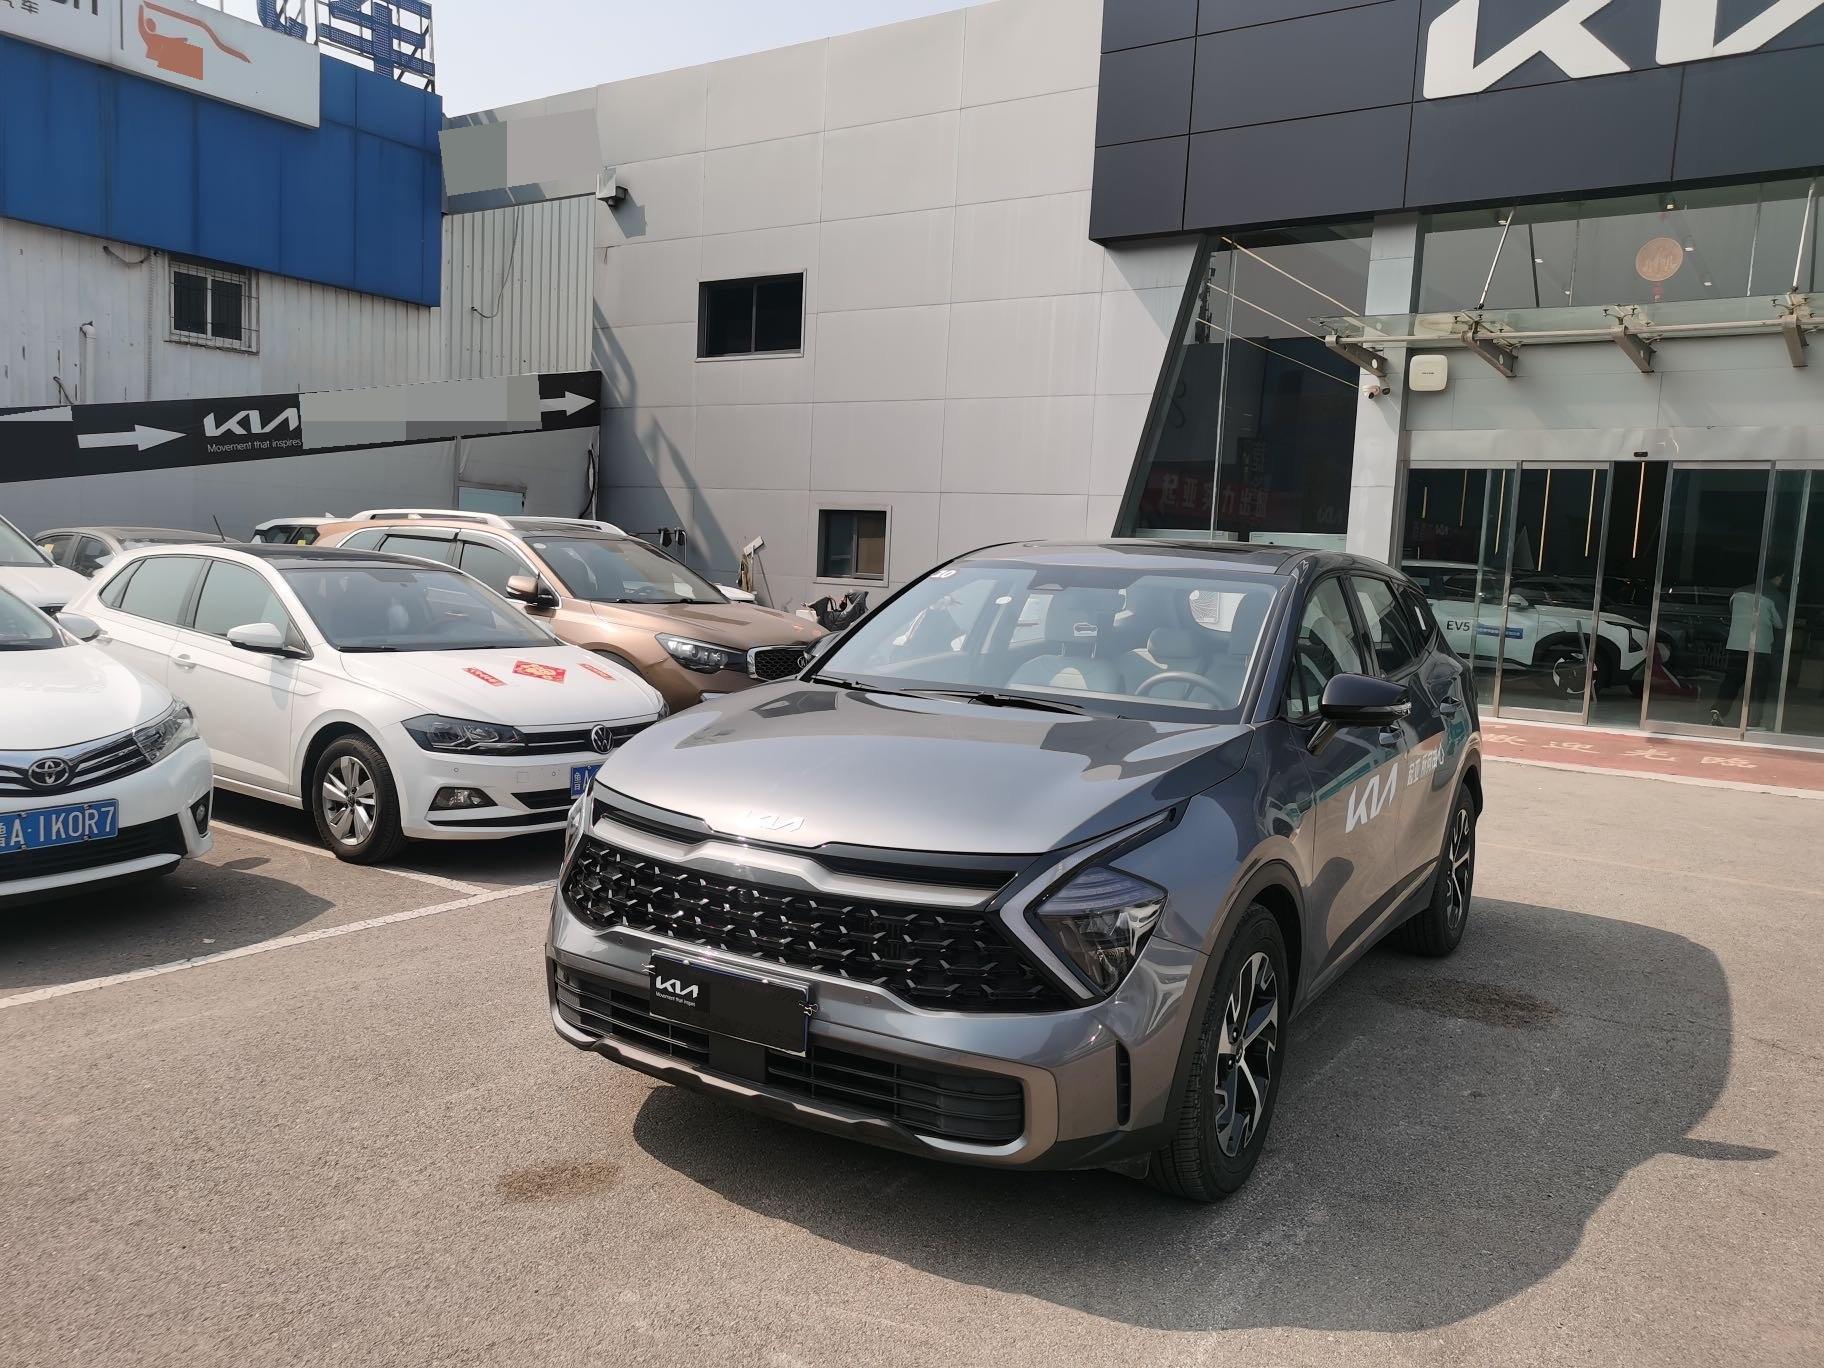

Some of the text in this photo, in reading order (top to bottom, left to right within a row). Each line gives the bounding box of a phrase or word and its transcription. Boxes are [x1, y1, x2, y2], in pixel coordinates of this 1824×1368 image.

[1423, 0, 1824, 99] KI
[203, 407, 299, 437] KIA
[207, 438, 302, 453] Movement that inspires
[1446, 620, 1471, 632] EV5
[1345, 762, 1398, 833] KIA
[656, 975, 699, 998] KIA
